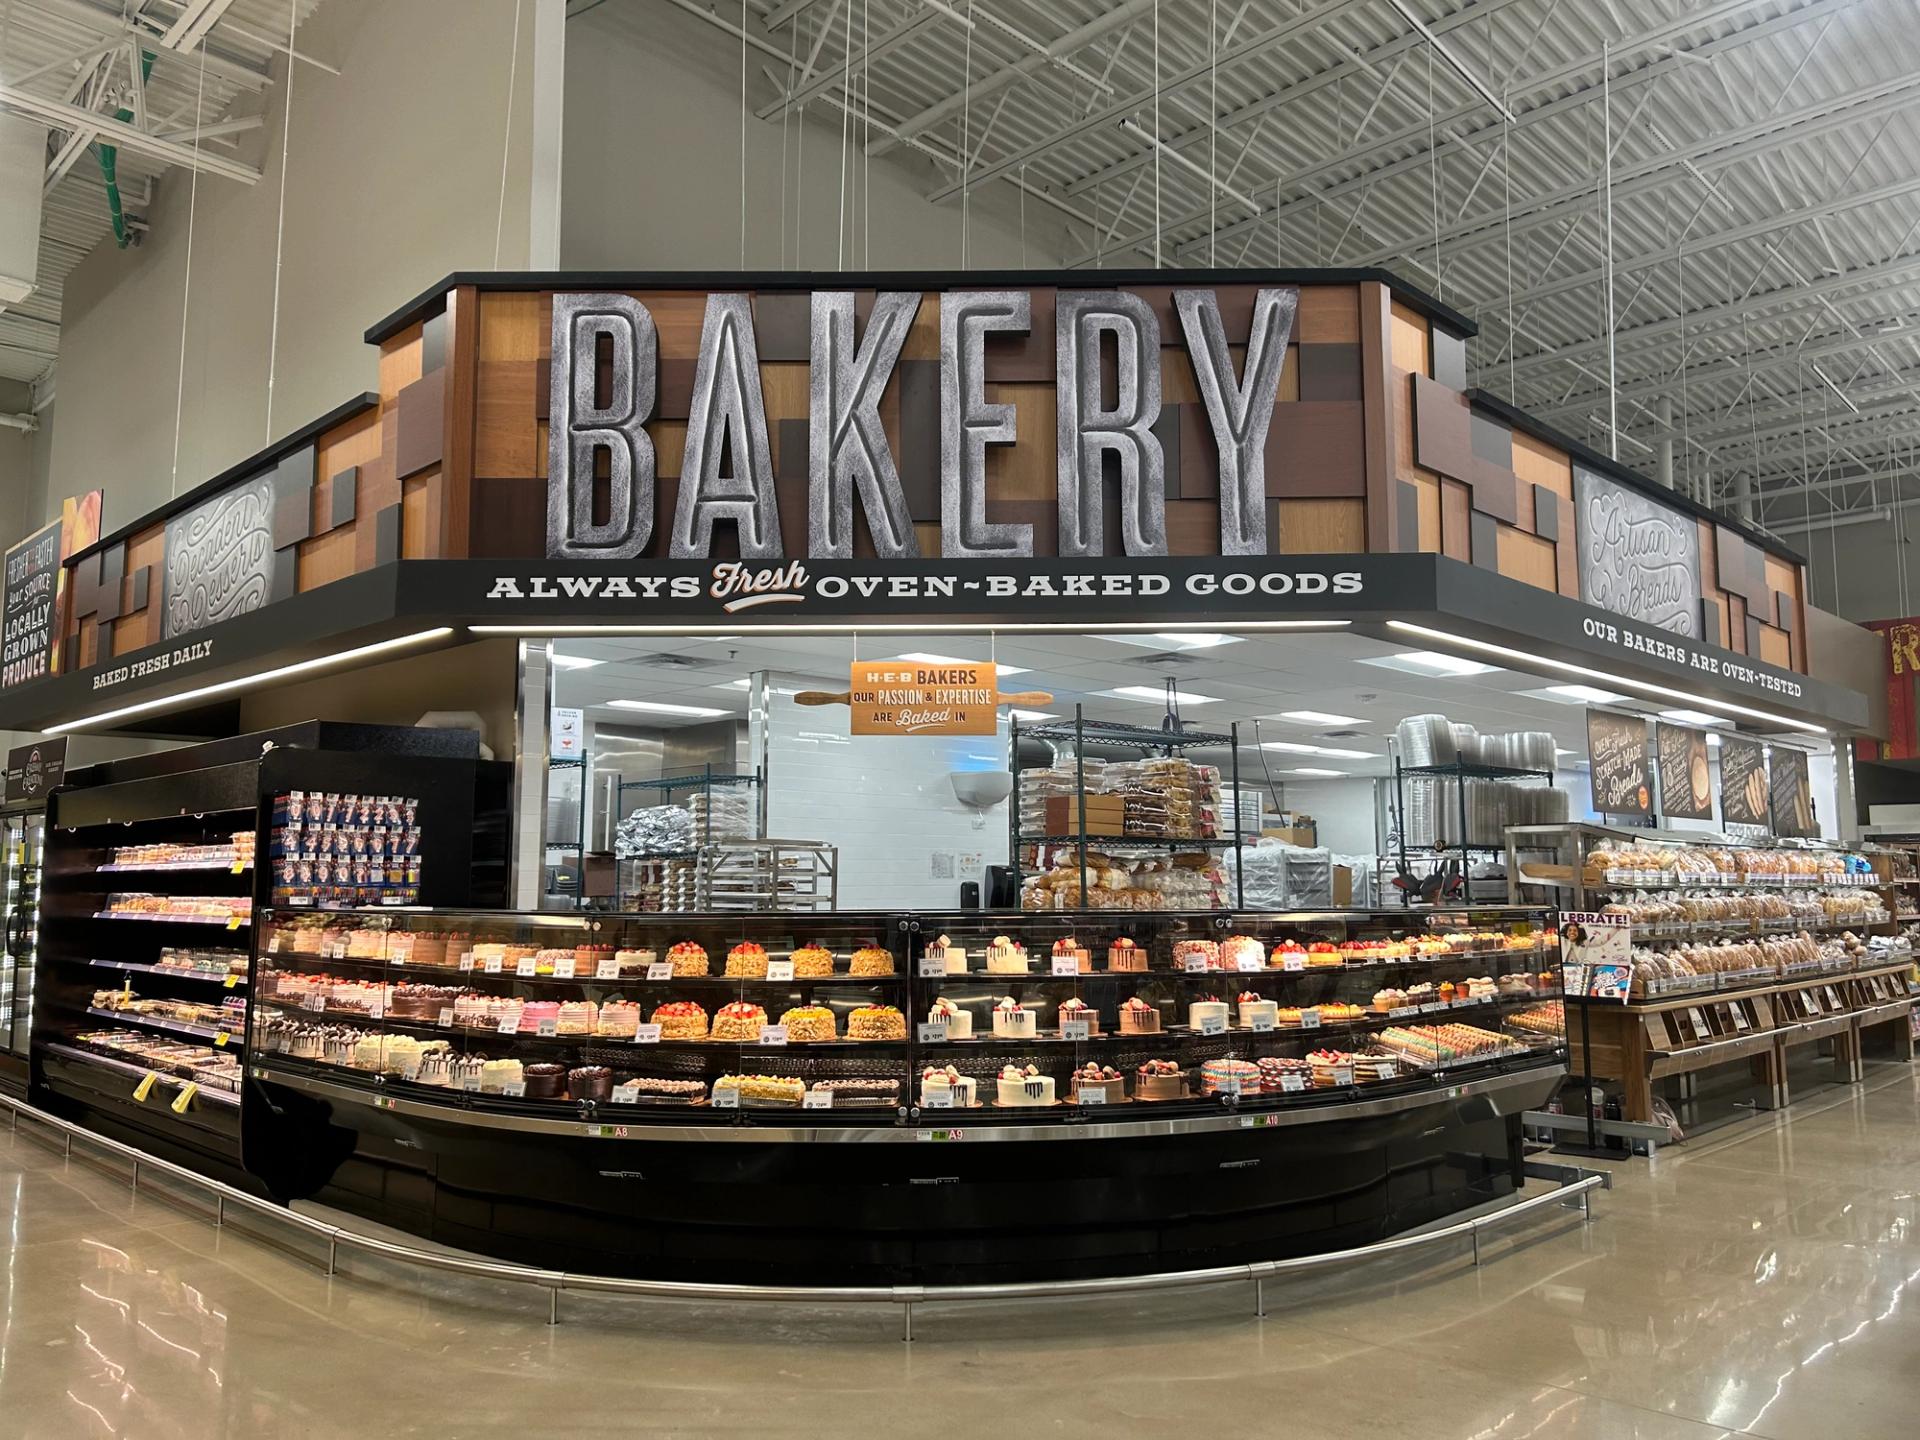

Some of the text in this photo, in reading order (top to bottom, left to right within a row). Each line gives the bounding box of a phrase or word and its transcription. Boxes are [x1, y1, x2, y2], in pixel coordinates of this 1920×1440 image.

[546, 288, 1298, 560] BAKERY
[24, 572, 51, 601] SOURCE
[486, 576, 700, 598] ALWAYS
[710, 560, 810, 598] Fresh
[1185, 572, 1364, 595] GOODS
[1619, 564, 1682, 617] Breads
[5, 601, 51, 642] LOCALLY
[4, 626, 50, 663] GROWN
[1583, 617, 1801, 698] OUR BAKERS ARE OVEN-TESTED
[2, 650, 46, 690] PRODUCE
[92, 639, 214, 691] BAKED FRESH DAILY
[917, 669, 978, 685] BAKERS
[853, 688, 992, 705] OUR PASSION & EXPERTISE
[872, 707, 966, 726] ARE Baked IN
[615, 1127, 628, 1137] A8
[949, 1129, 963, 1140] A9
